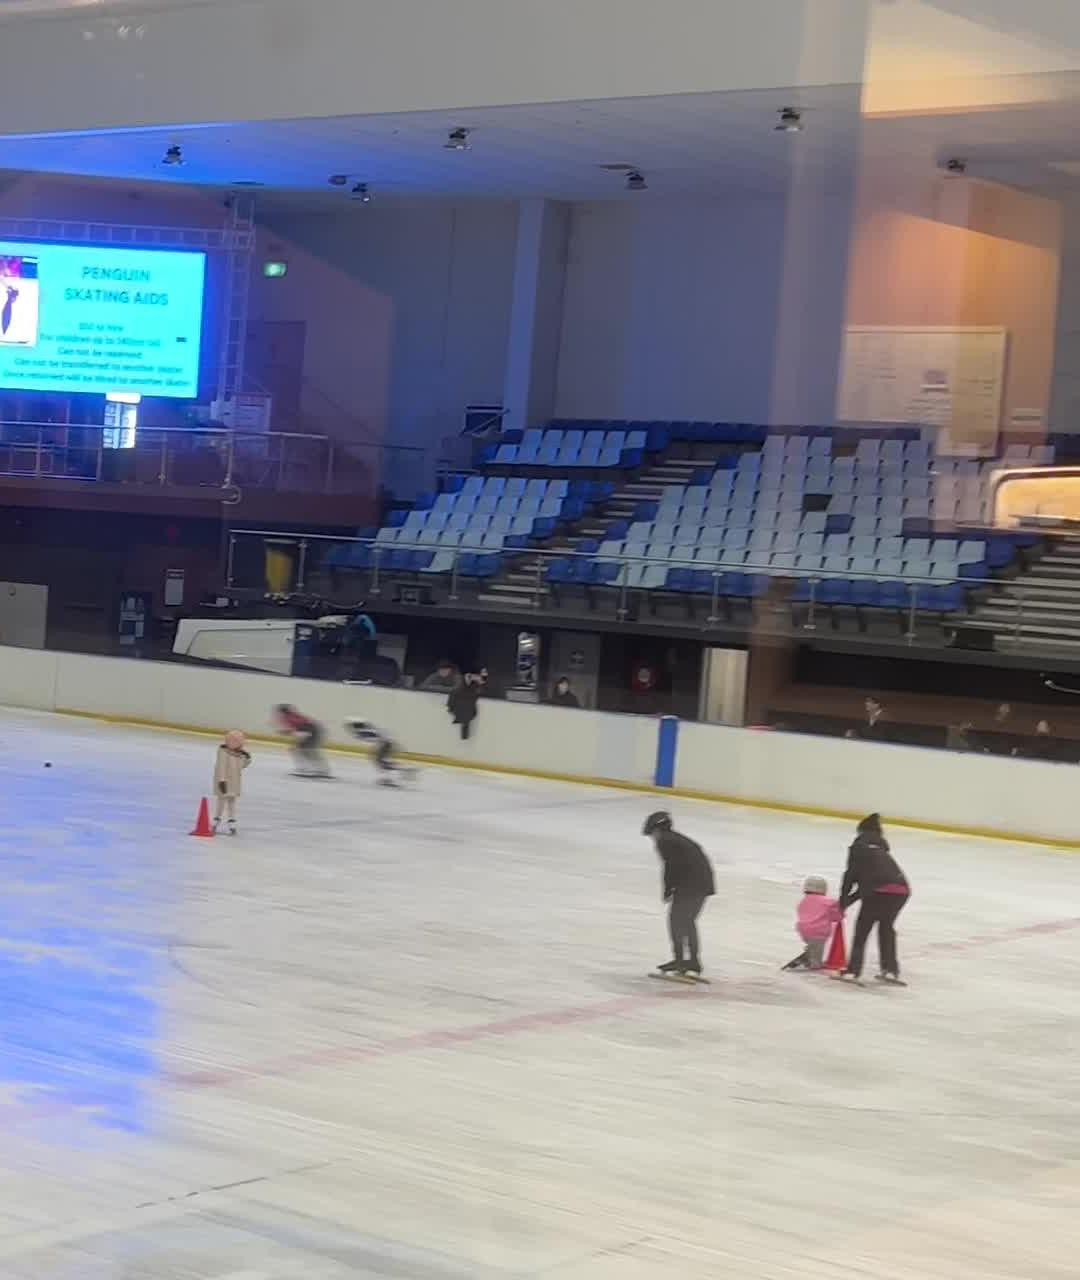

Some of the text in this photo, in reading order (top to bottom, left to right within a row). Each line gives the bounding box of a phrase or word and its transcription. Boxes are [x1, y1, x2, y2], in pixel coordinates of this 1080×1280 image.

[81, 266, 150, 282] PENGUIN
[64, 287, 168, 306] SKATING AIDS
